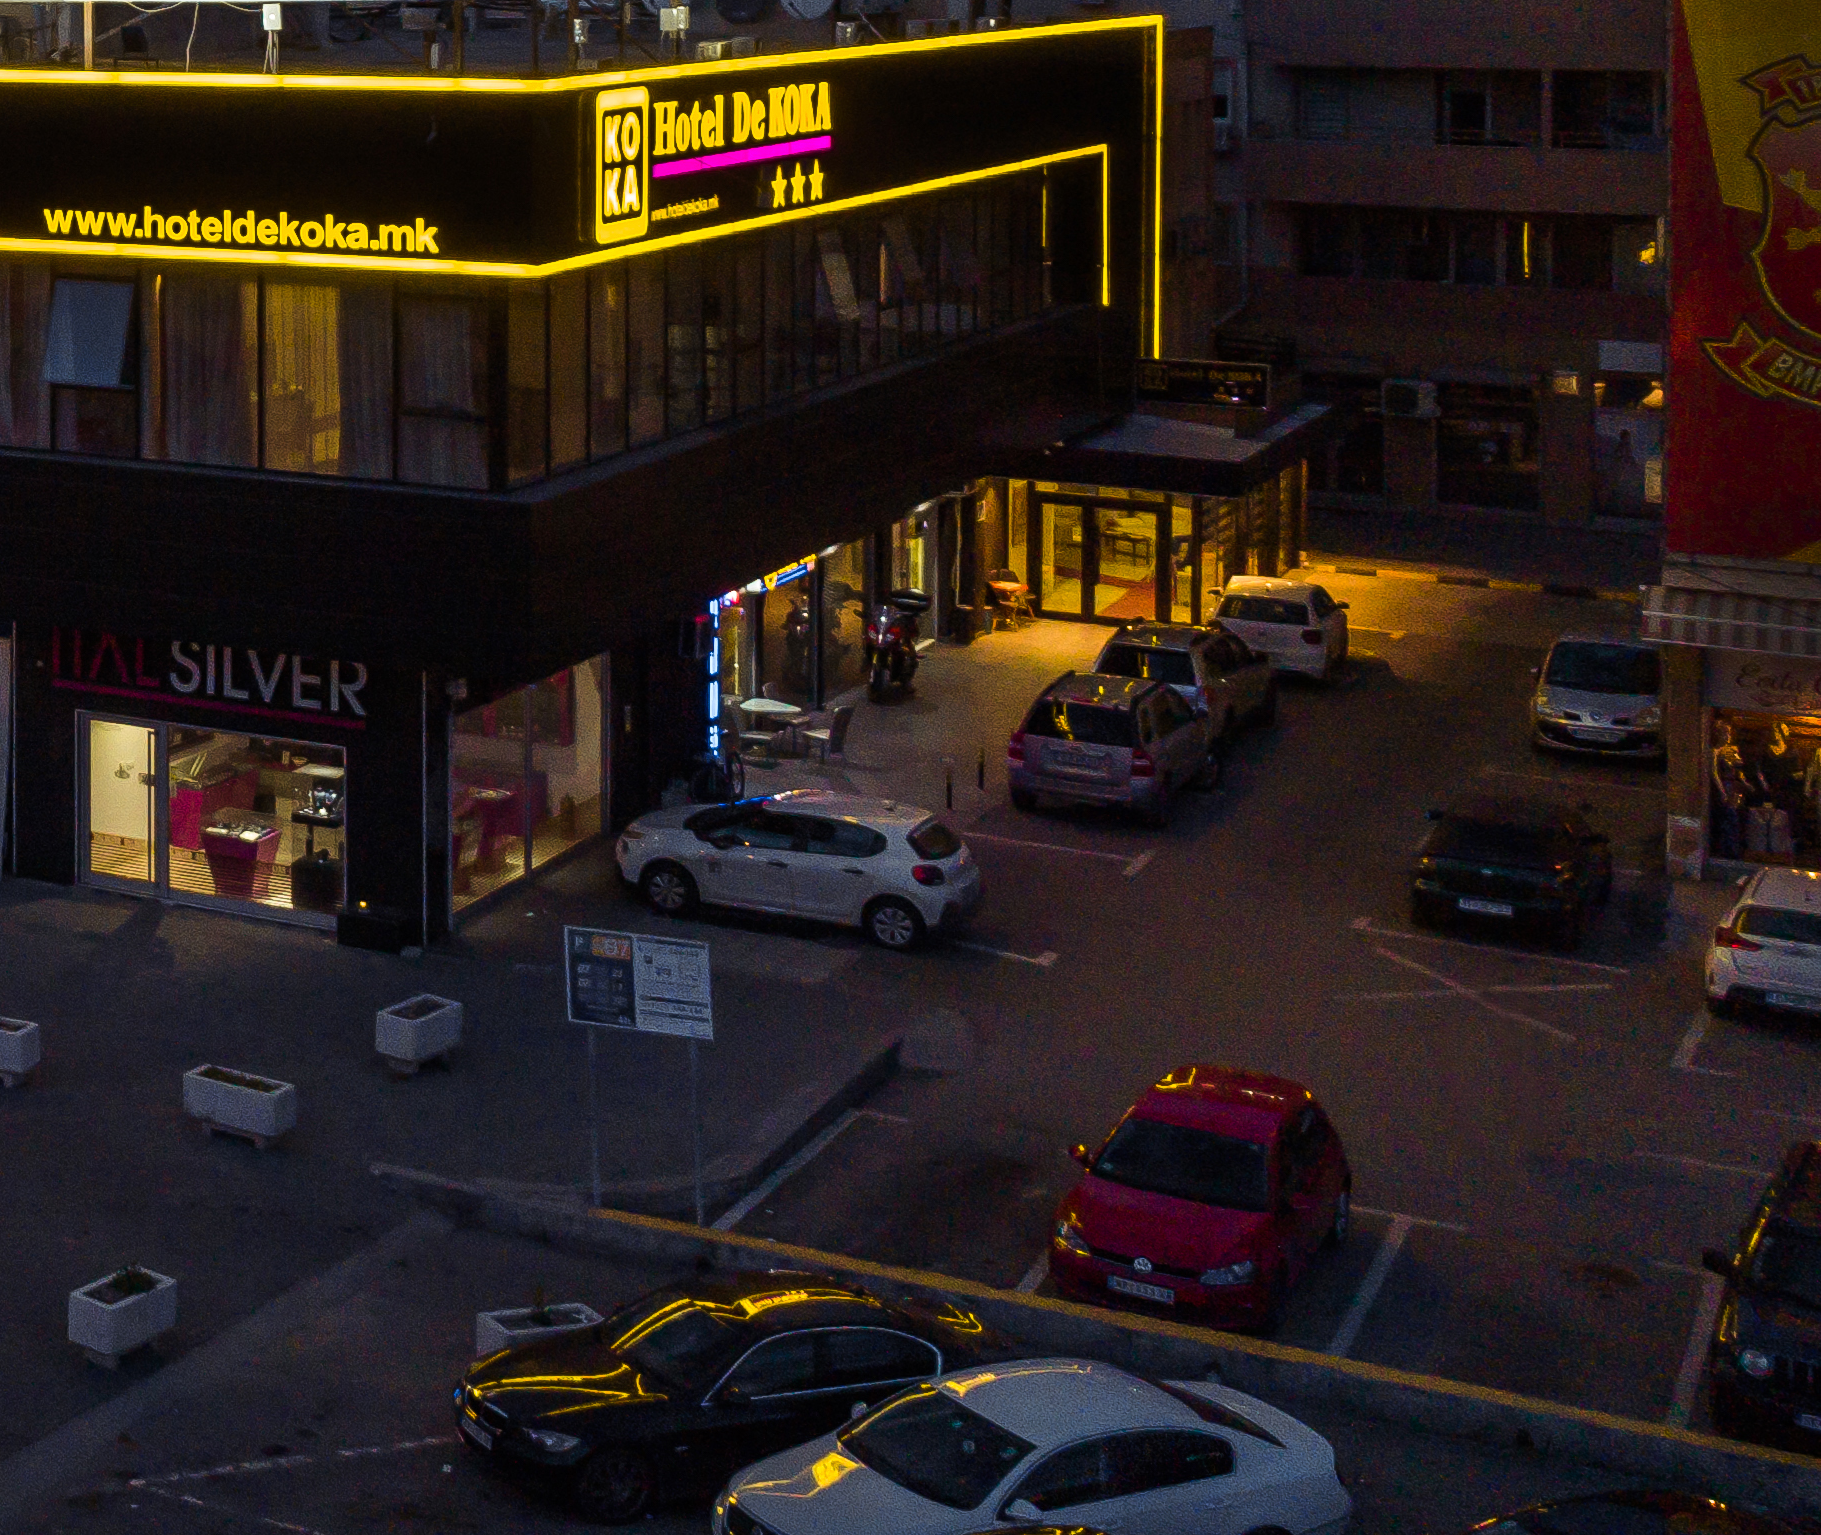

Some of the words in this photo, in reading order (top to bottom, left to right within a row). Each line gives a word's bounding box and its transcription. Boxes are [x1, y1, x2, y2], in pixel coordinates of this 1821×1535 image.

[652, 93, 725, 156] Hotel
[43, 205, 440, 254] www.hoteldekoka.mk
[168, 639, 368, 717] SILVER
